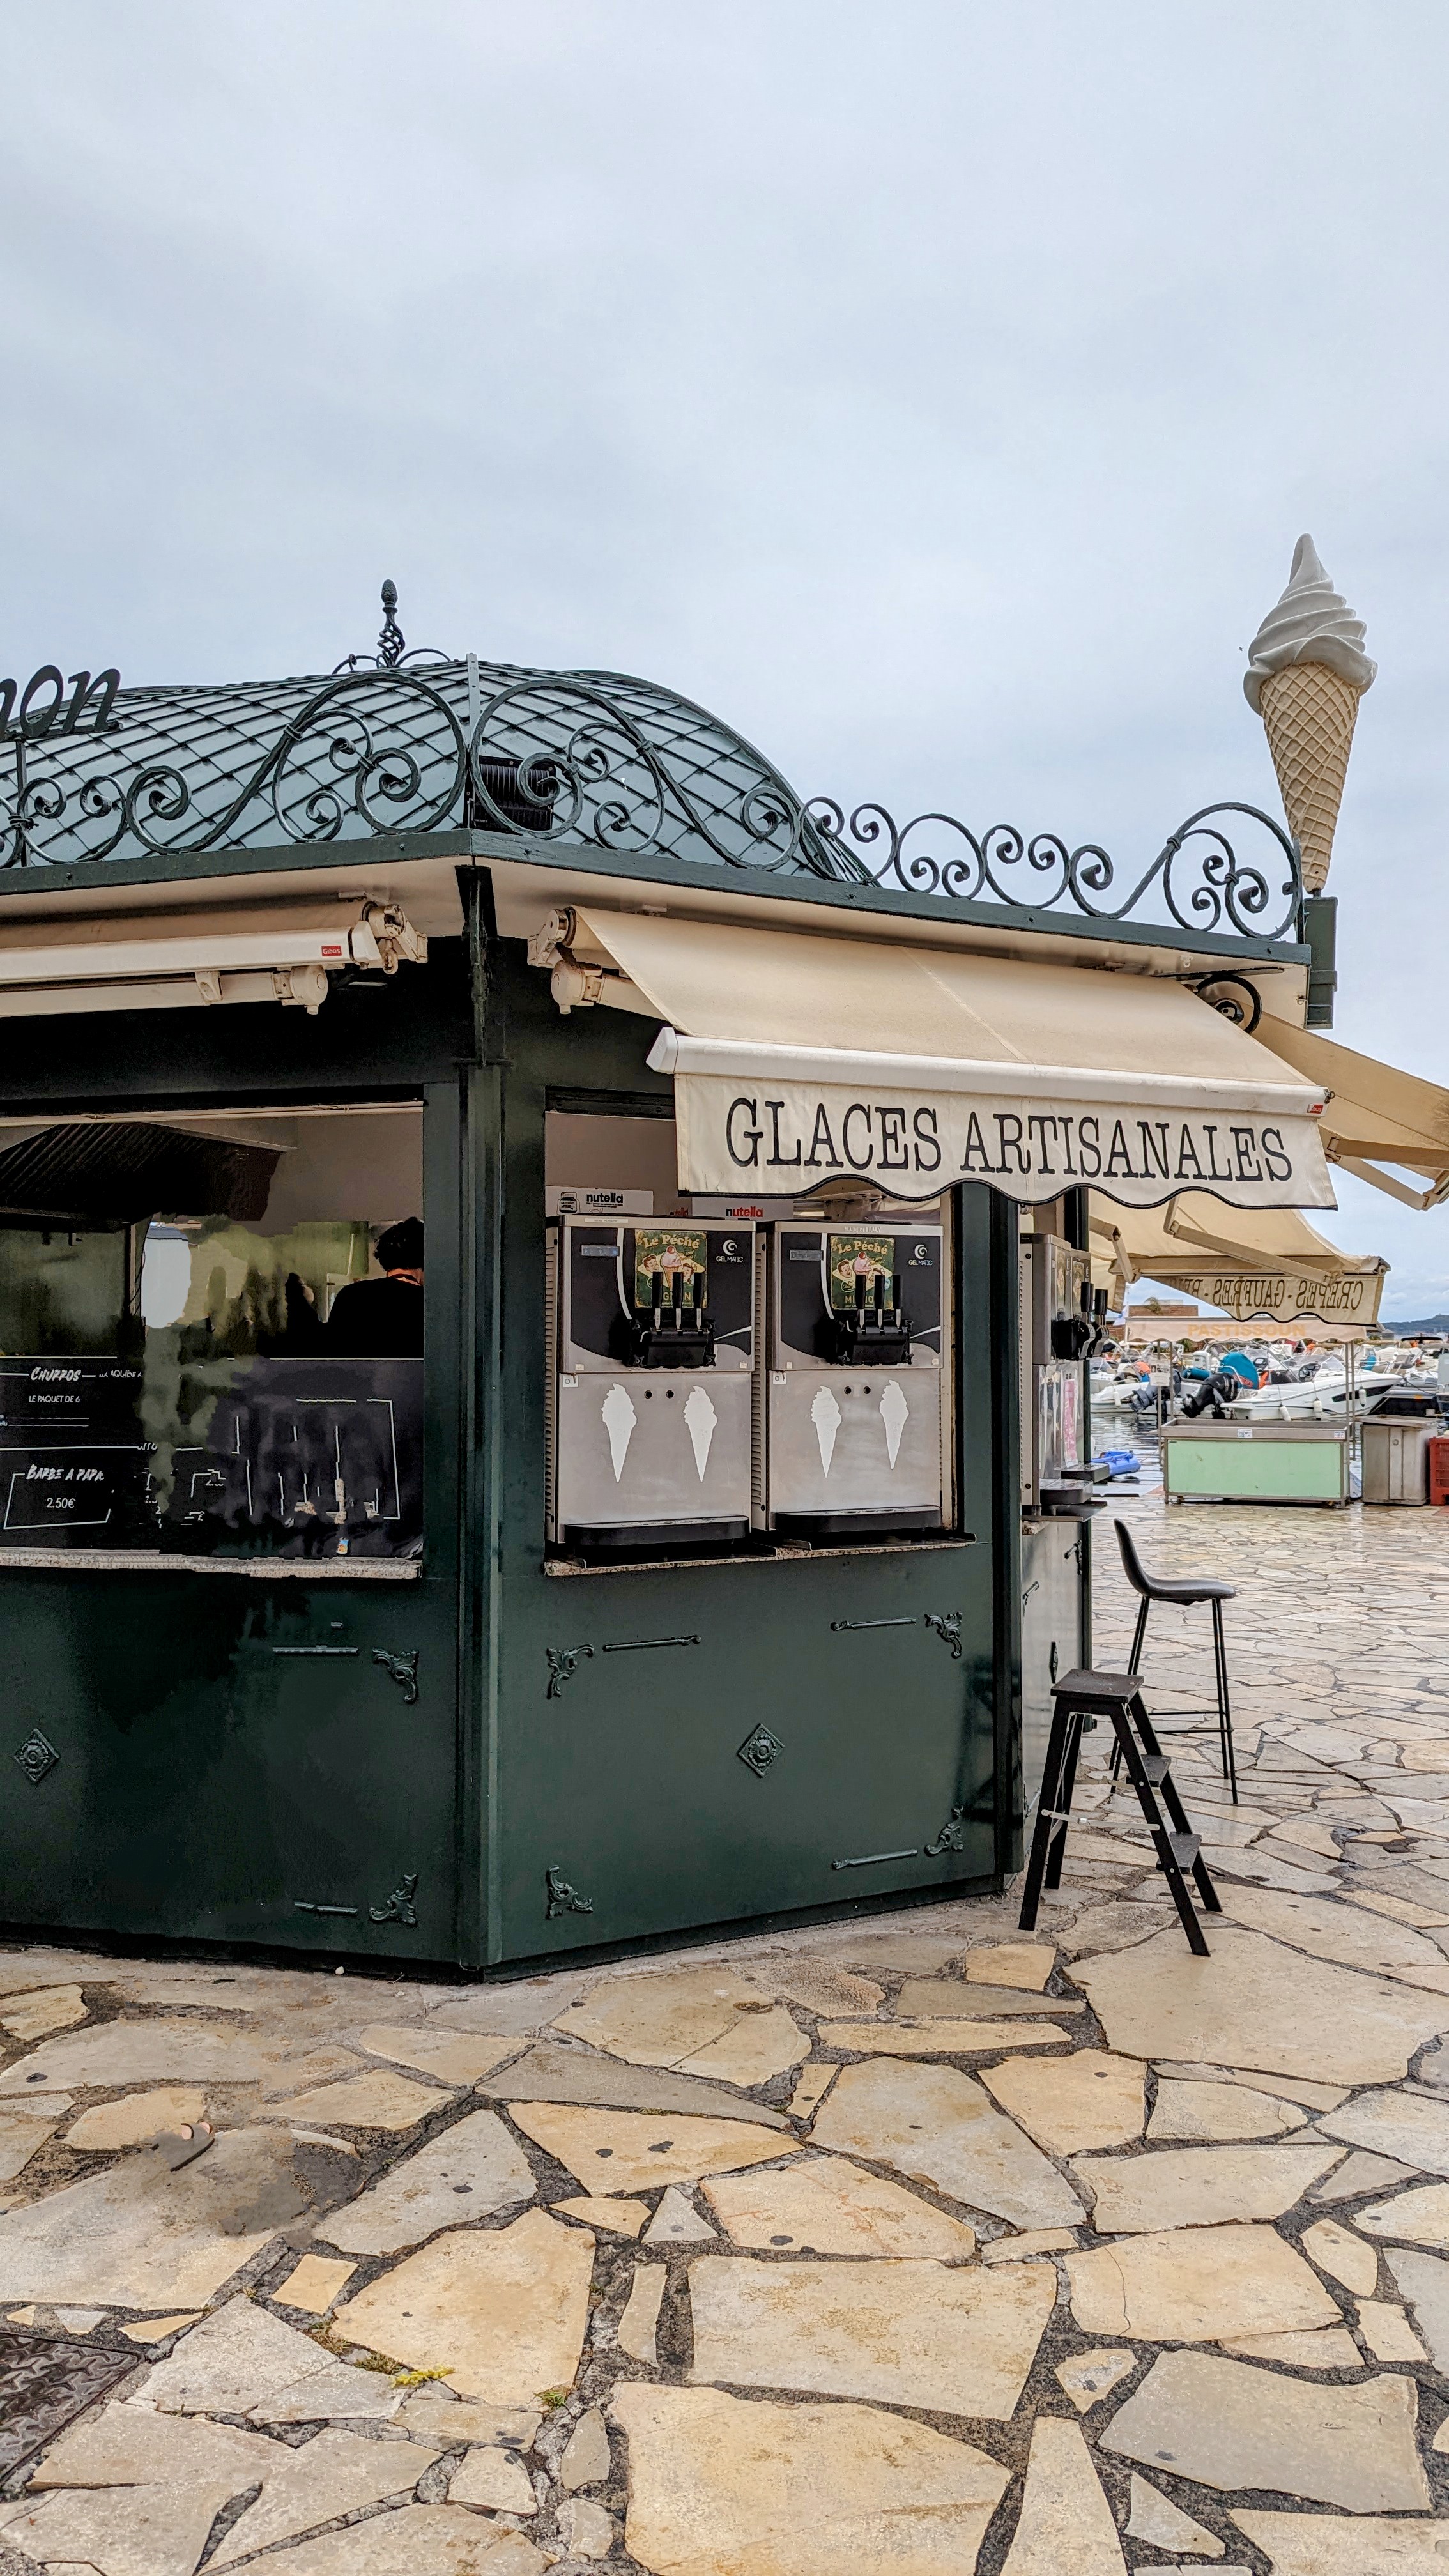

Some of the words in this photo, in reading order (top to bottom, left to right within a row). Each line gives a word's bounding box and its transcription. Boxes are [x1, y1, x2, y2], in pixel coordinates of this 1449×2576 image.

[726, 1097, 942, 1172] GLACES
[960, 1111, 1293, 1182] ARTISANALES
[586, 1192, 624, 1203] nutella
[726, 1206, 763, 1217] nutella
[643, 1238, 659, 1248] Le
[661, 1234, 700, 1248] Péché
[837, 1243, 852, 1254] Le
[854, 1241, 888, 1255] Péché
[1187, 1324, 1306, 1337] PASTISSOUN
[31, 1367, 82, 1381] CHURROS
[26, 1464, 62, 1480] BARBE
[65, 1468, 75, 1480] A
[46, 1498, 76, 1508] 2.50€
